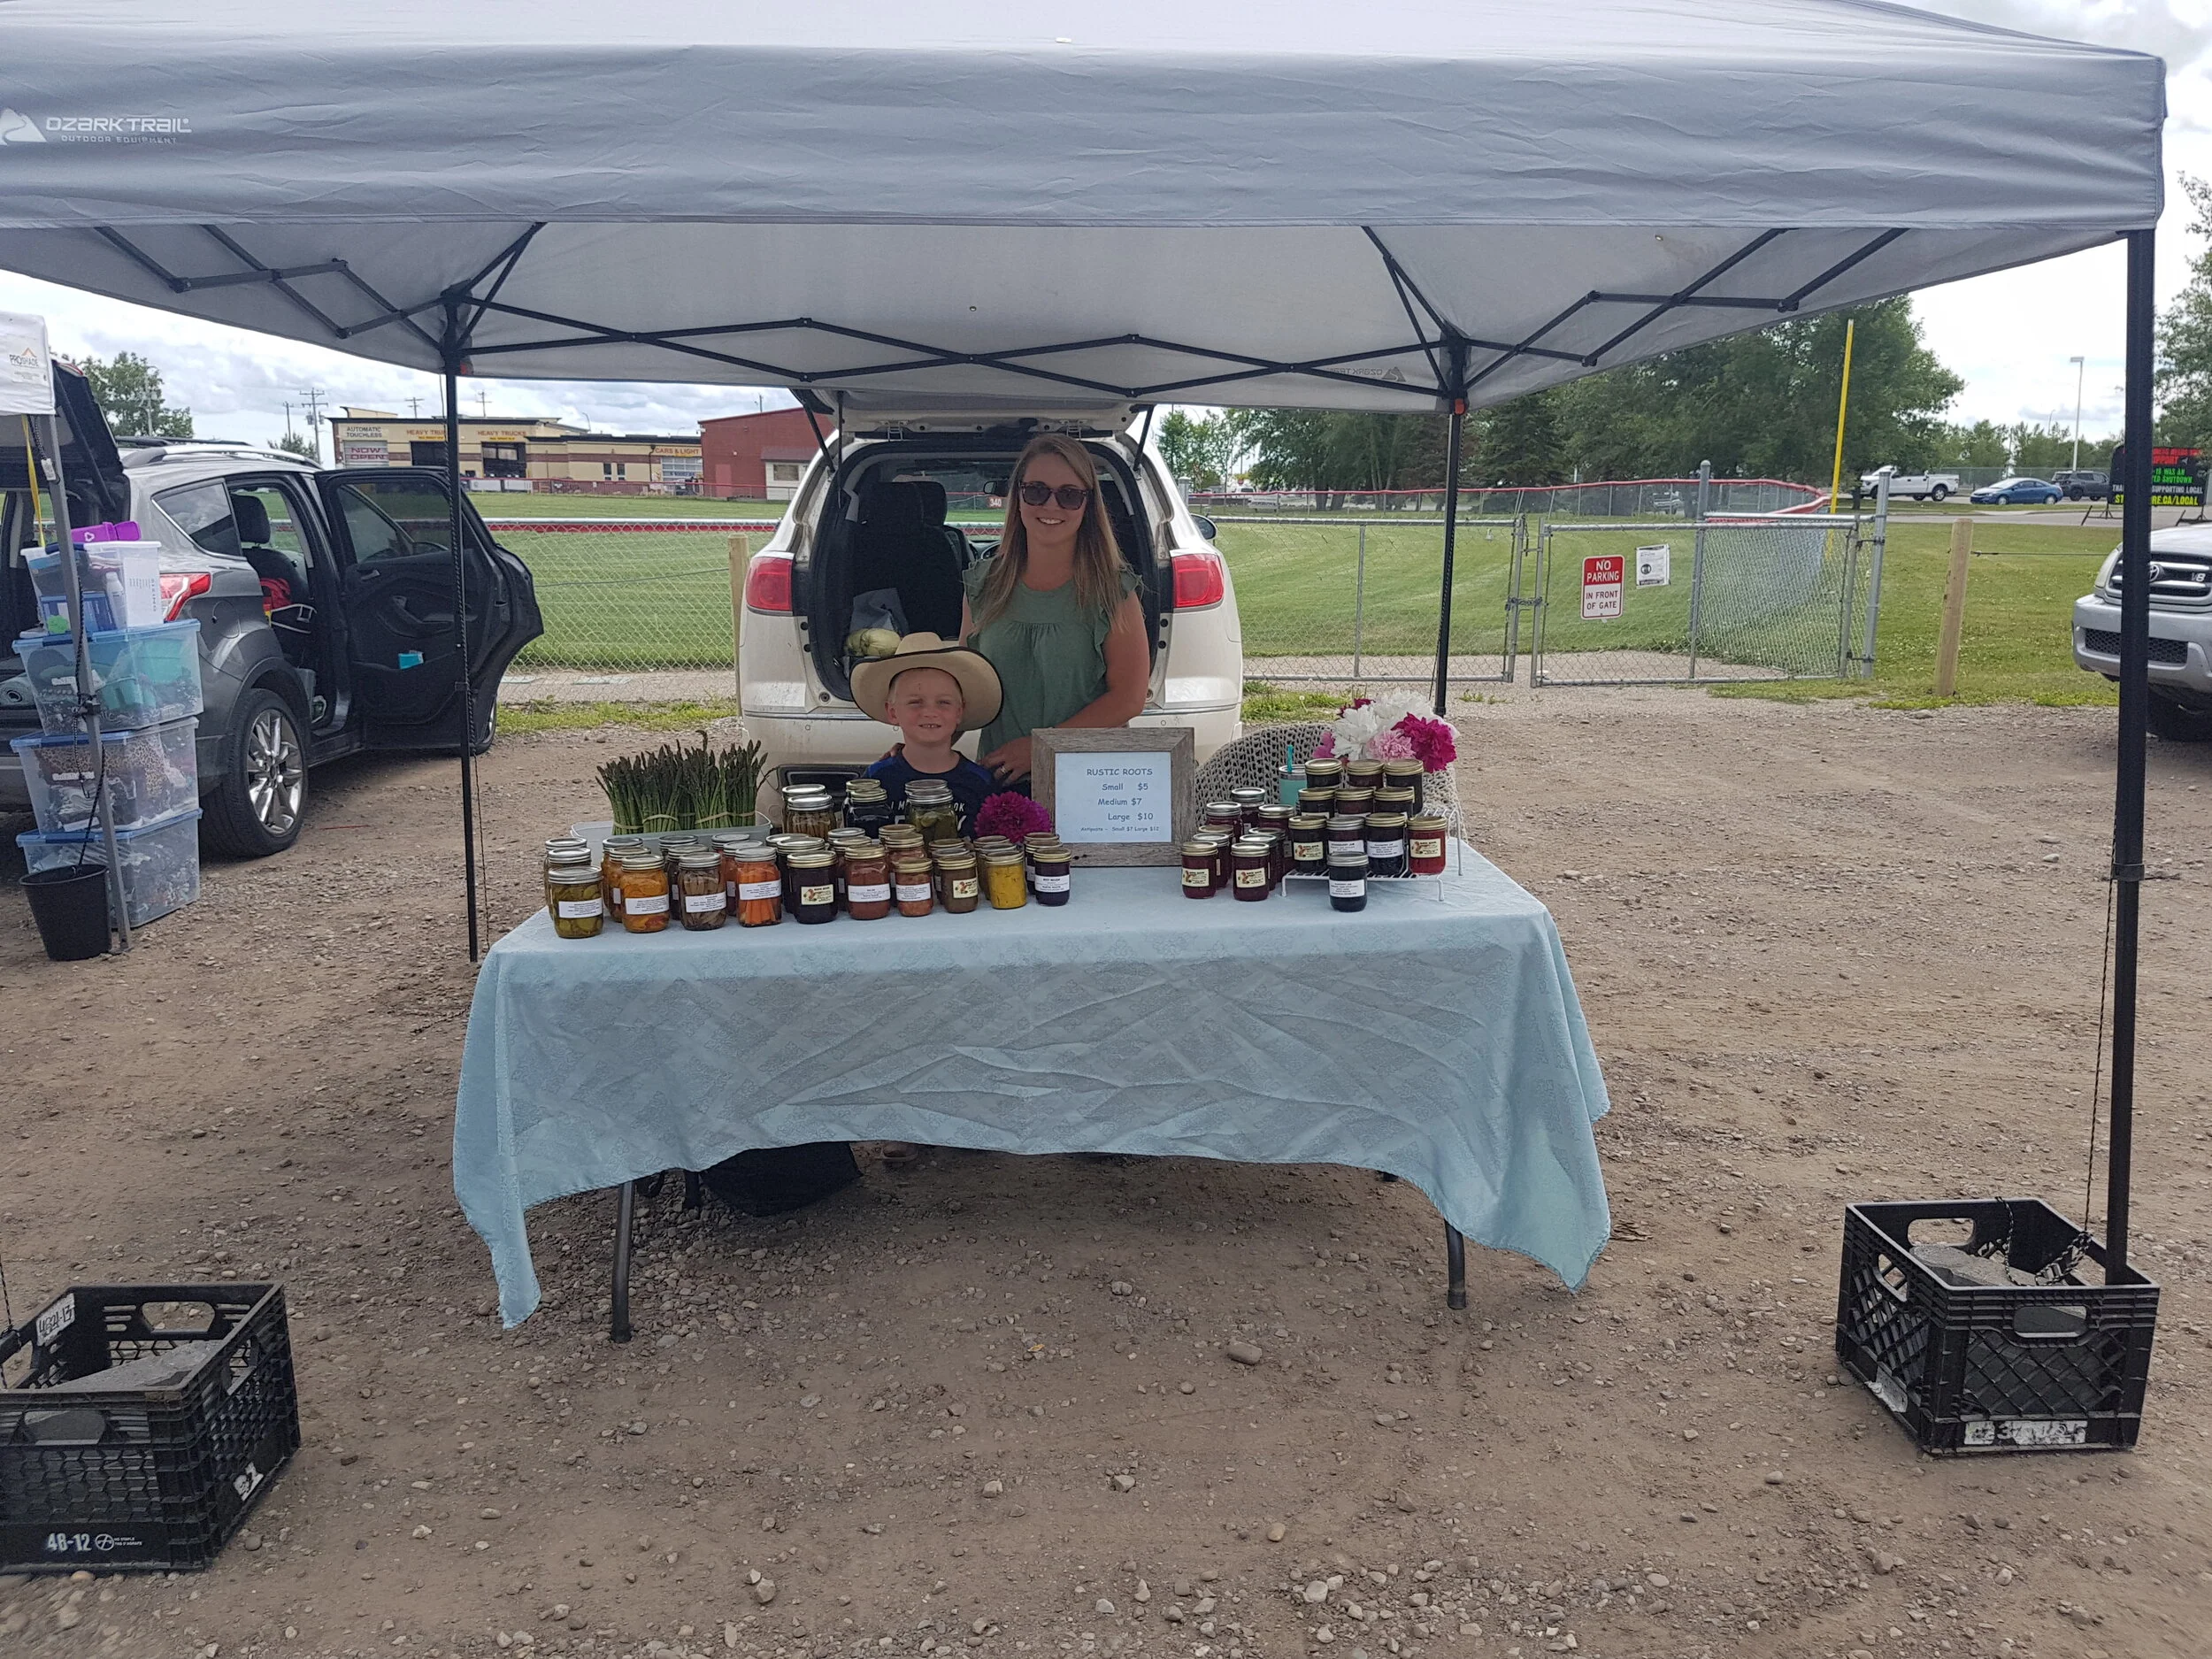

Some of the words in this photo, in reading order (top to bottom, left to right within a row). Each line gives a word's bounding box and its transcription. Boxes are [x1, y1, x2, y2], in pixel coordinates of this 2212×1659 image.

[1595, 560, 1611, 571] NO
[1586, 571, 1619, 582] PARKING
[2191, 572, 2206, 581] V8
[1595, 590, 1618, 599] FRONT
[1108, 813, 1131, 822] Large
